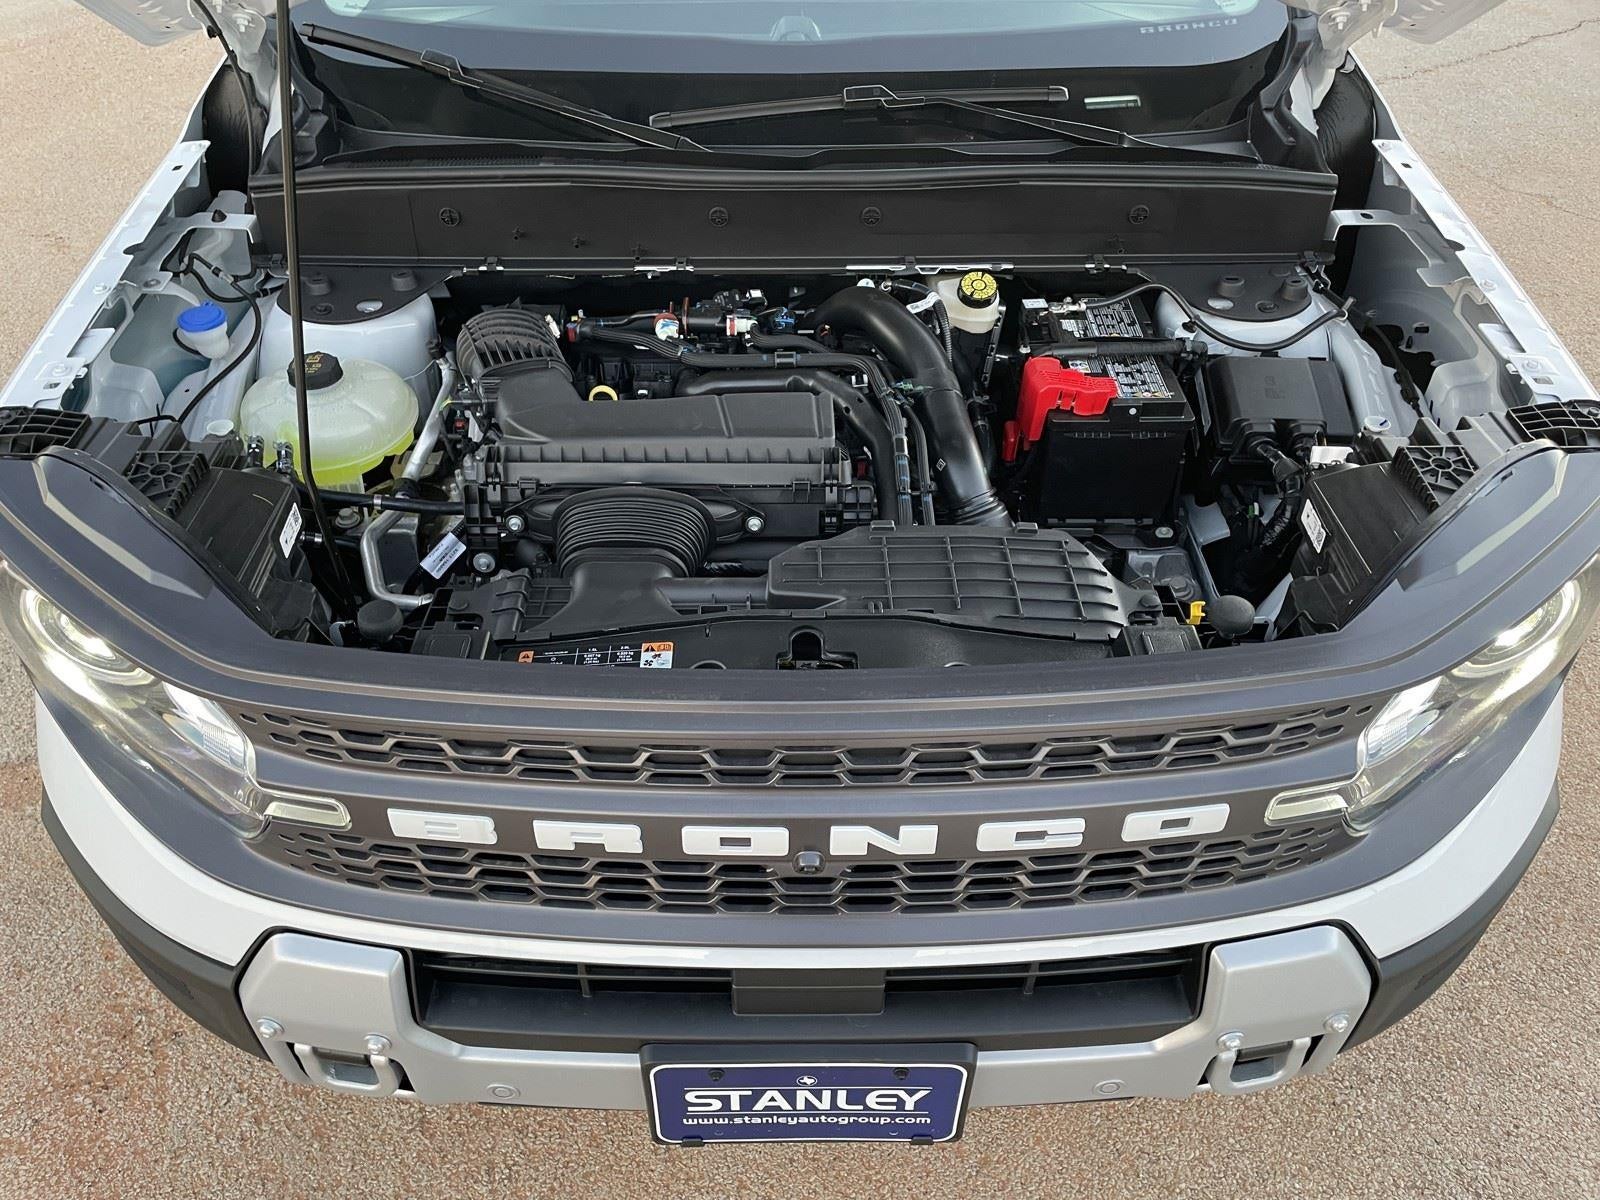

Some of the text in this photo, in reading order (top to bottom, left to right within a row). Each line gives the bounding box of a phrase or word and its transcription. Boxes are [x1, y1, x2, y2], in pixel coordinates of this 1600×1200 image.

[1139, 18, 1237, 34] BRONCO
[387, 803, 1231, 856] BRONCO
[684, 1089, 932, 1112] STANLEY
[683, 1115, 931, 1126] www.stanleyautogroup.com
